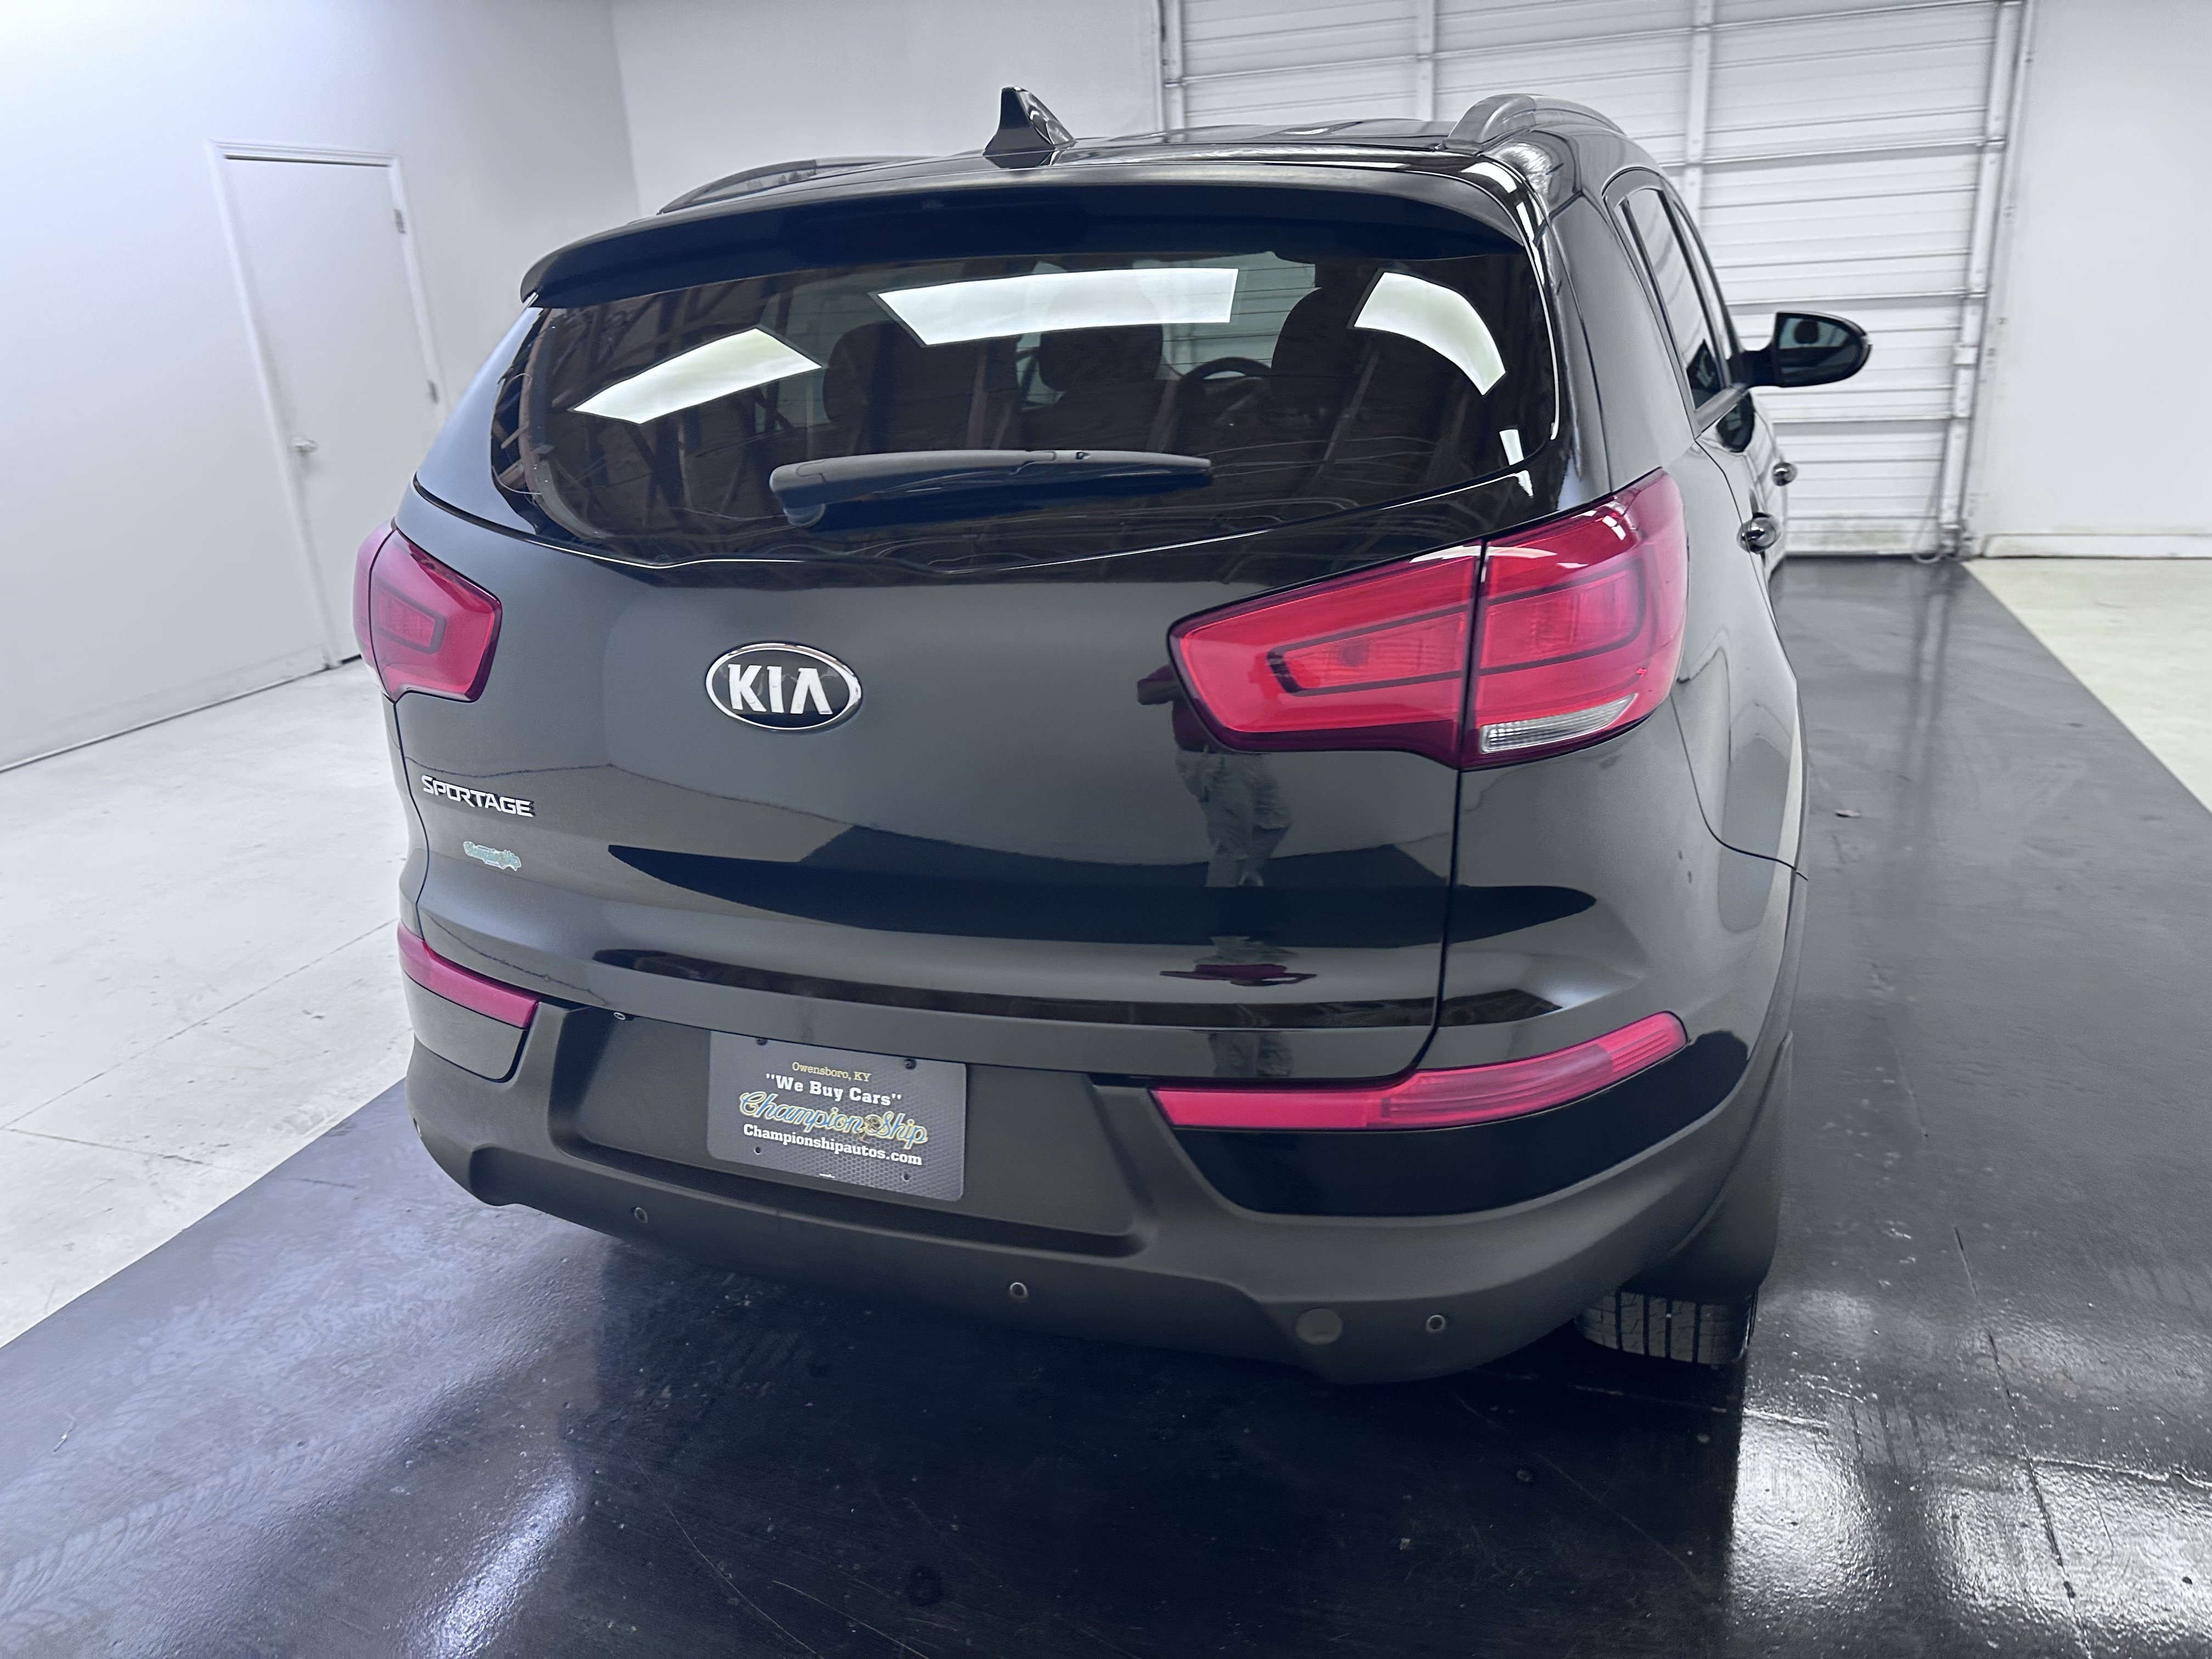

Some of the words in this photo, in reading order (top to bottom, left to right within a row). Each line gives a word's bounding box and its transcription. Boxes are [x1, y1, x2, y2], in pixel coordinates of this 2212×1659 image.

[727, 664, 833, 714] KIA
[421, 775, 534, 817] SPORTAGE
[792, 1062, 851, 1081] Owensboro,
[854, 1072, 871, 1082] KY
[810, 1080, 844, 1102] Buy
[743, 1123, 922, 1166] Championshipautos.com
